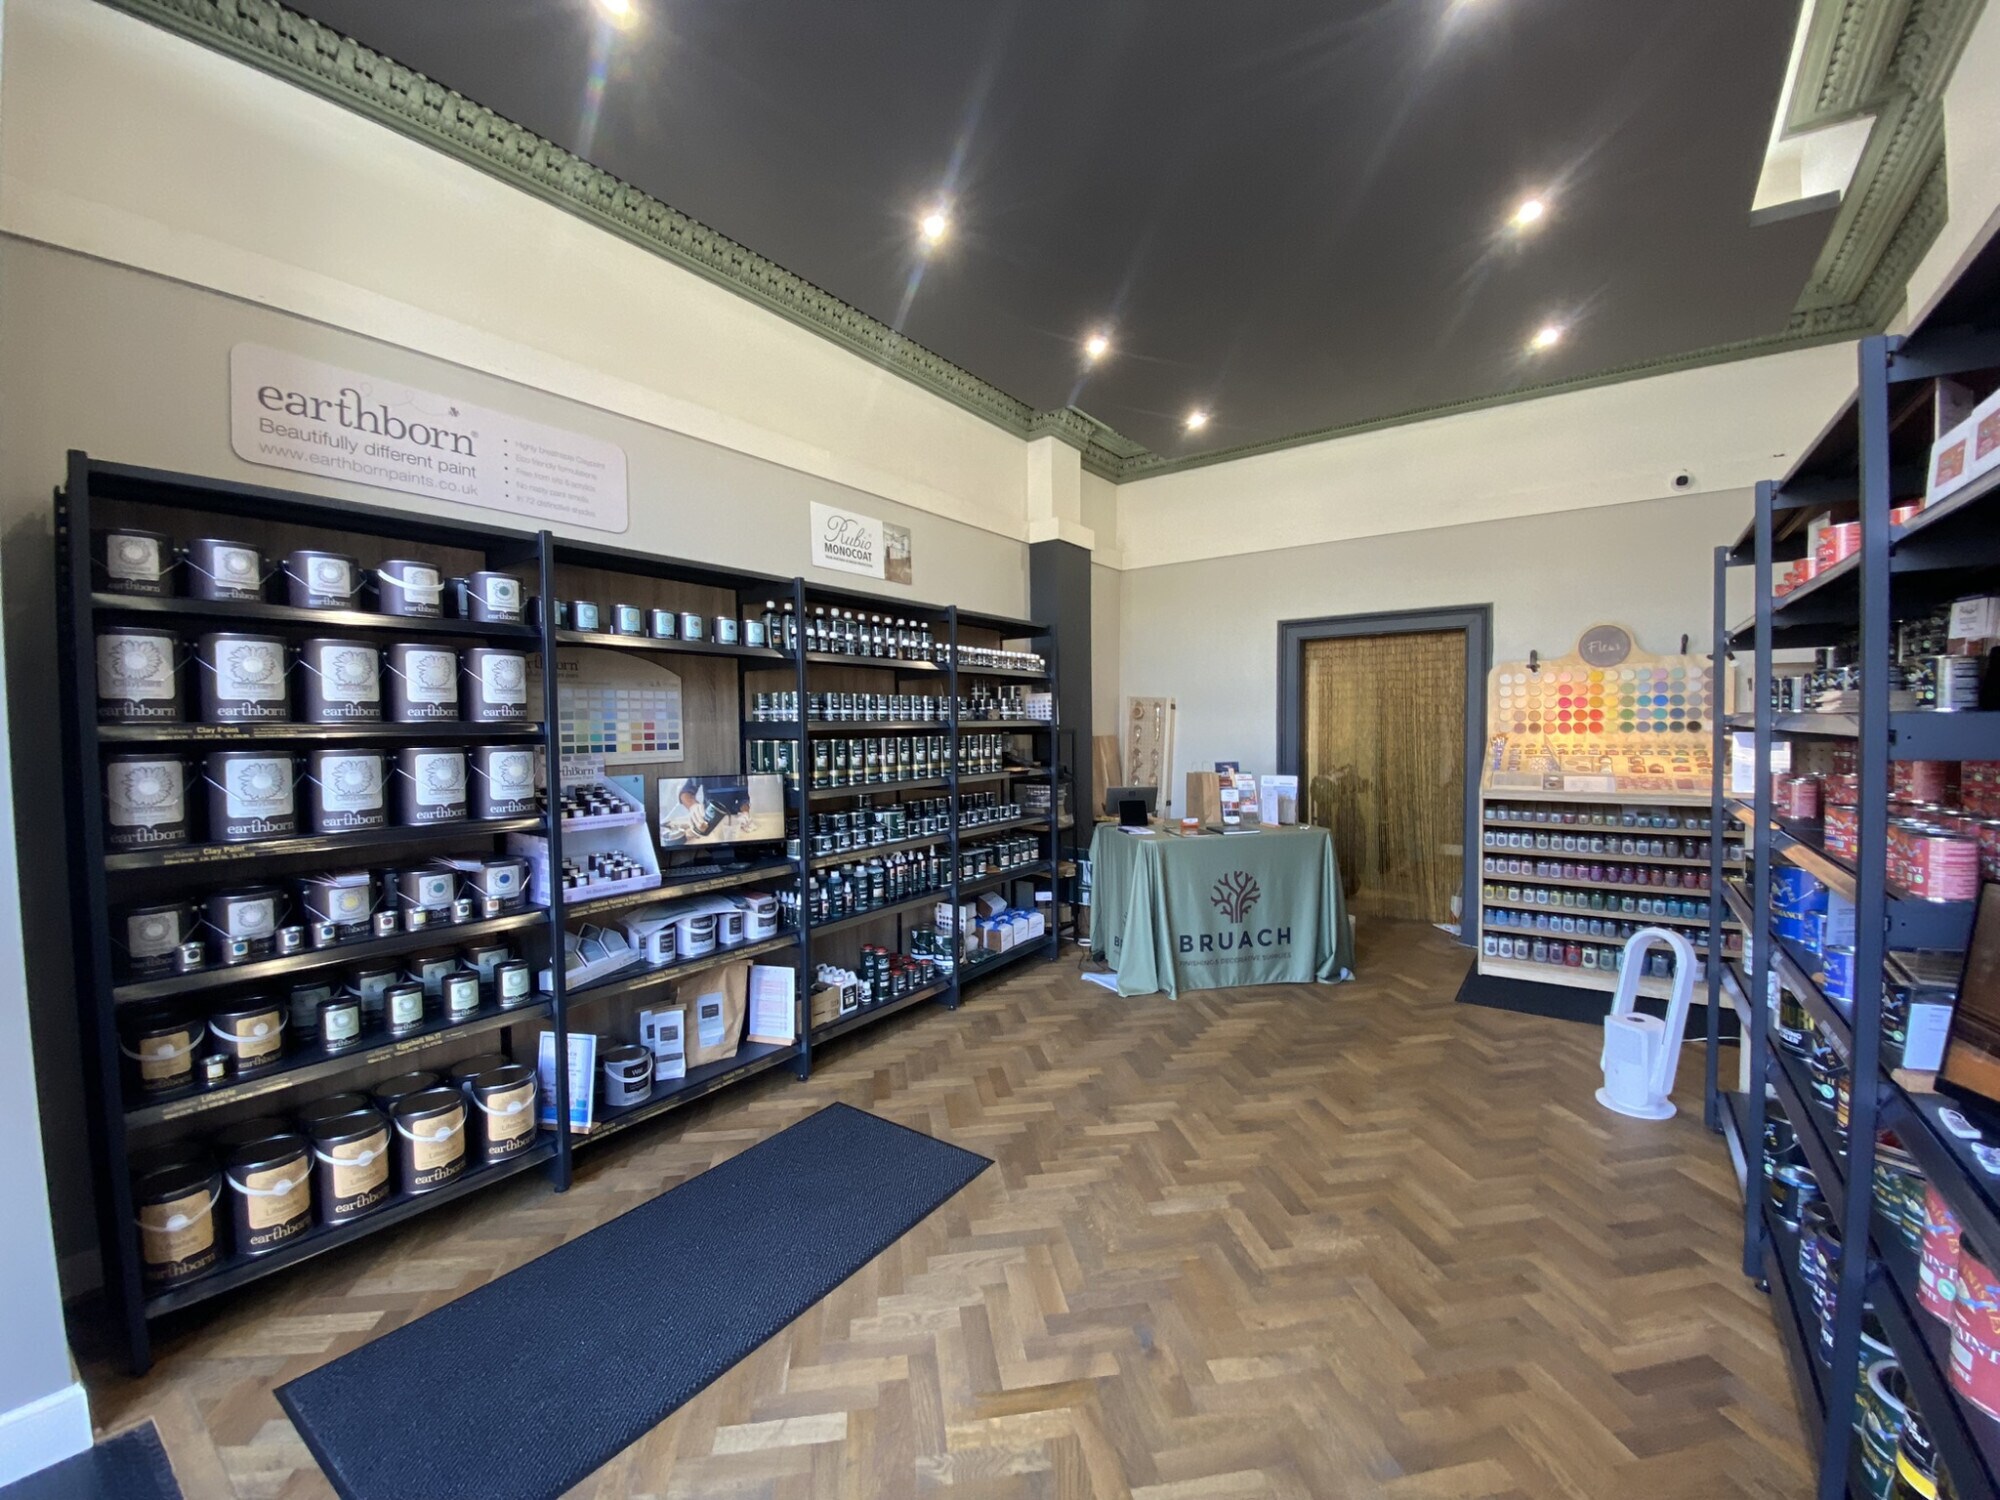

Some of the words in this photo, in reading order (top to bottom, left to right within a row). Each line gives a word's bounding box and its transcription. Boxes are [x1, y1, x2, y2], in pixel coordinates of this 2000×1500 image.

[258, 385, 477, 457] earthborn
[259, 417, 358, 455] Beautifully
[364, 442, 433, 469] different
[438, 458, 478, 480] paint
[259, 442, 479, 497] www.earthbornpaints.co.uk
[823, 515, 873, 550] Rubio
[824, 542, 873, 563] MONOCOAT
[99, 702, 176, 717] earthborn
[217, 702, 287, 717] earthborn
[322, 703, 380, 717] earthborn
[408, 704, 458, 717] earthborn
[483, 704, 527, 717] earthborn
[416, 806, 467, 820] earthborn
[490, 800, 536, 814] earthborn
[227, 818, 294, 835] earthborn
[322, 813, 384, 828] earthborn
[110, 827, 186, 844] earthborn
[1179, 926, 1291, 953] BRUACH
[489, 1133, 536, 1155] earthborn
[415, 1160, 466, 1185] earthborn
[335, 1187, 389, 1213] earthborn
[250, 1217, 312, 1245] earthborn
